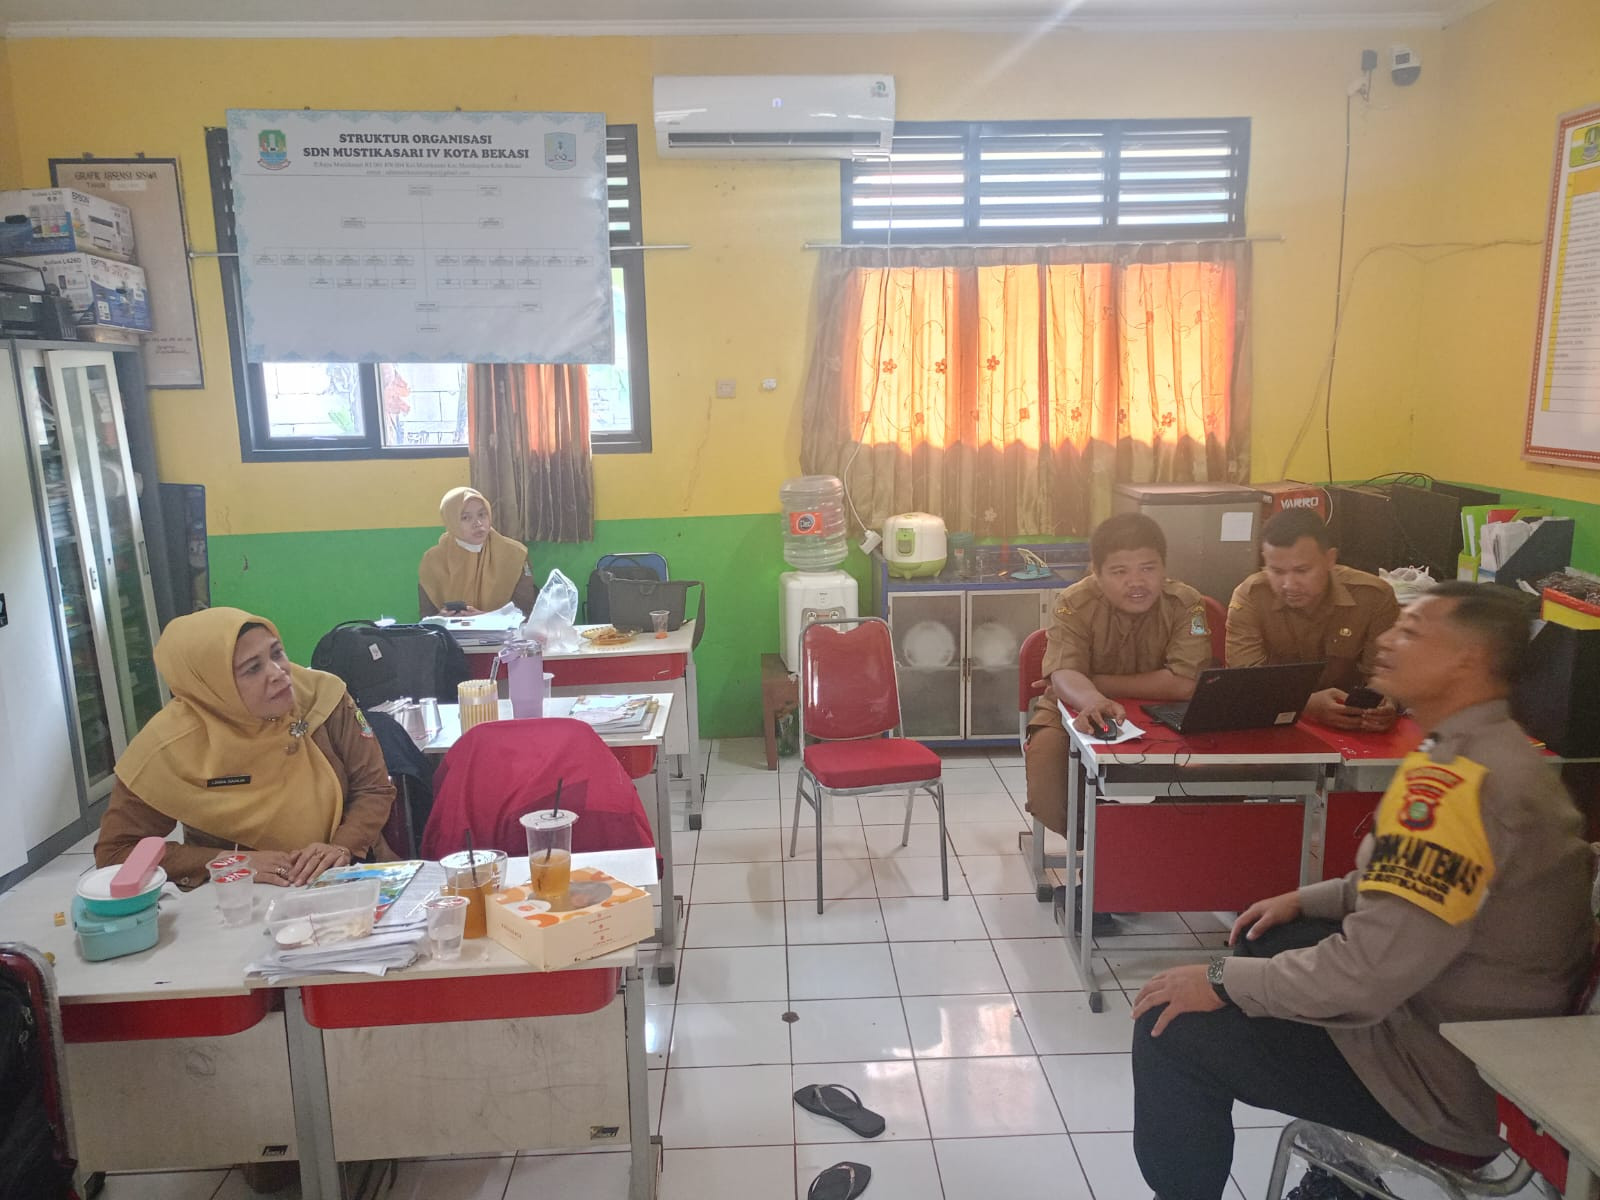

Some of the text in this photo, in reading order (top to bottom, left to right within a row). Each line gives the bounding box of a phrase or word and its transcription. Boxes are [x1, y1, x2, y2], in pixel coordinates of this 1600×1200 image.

[339, 133, 493, 144] STRUKTUR ORGANISASI
[303, 147, 530, 159] SDN MUSTIKASARI IV KOTA BEKASI
[72, 191, 90, 204] EPSON
[1280, 496, 1319, 510] VARRO
